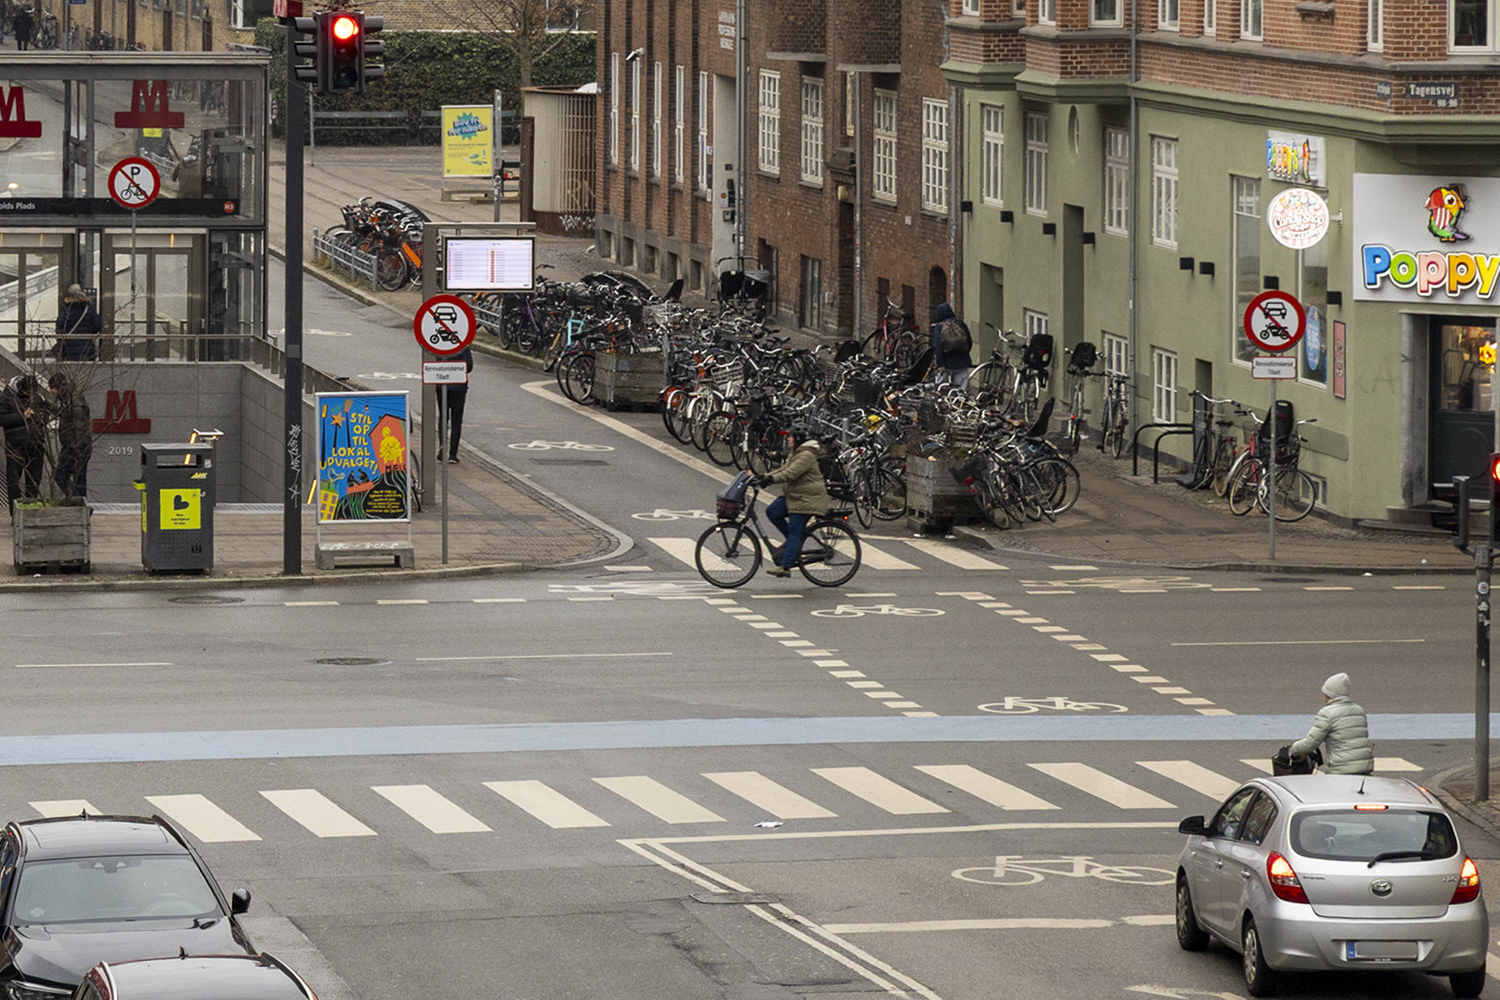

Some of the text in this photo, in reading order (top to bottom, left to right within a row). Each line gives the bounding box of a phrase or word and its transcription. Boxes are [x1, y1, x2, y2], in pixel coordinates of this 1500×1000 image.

[131, 79, 170, 112] M
[1409, 84, 1455, 97] Tagensvej
[131, 166, 141, 180] P
[16, 202, 36, 210] Plads
[1362, 245, 1500, 298] Poppy
[105, 390, 138, 419] M
[350, 413, 372, 424] STIL
[353, 425, 370, 435] OP
[352, 436, 369, 446] TIL
[109, 447, 133, 456] 2019
[332, 447, 370, 457] LOKAL
[320, 457, 378, 475] UDVALGET!
